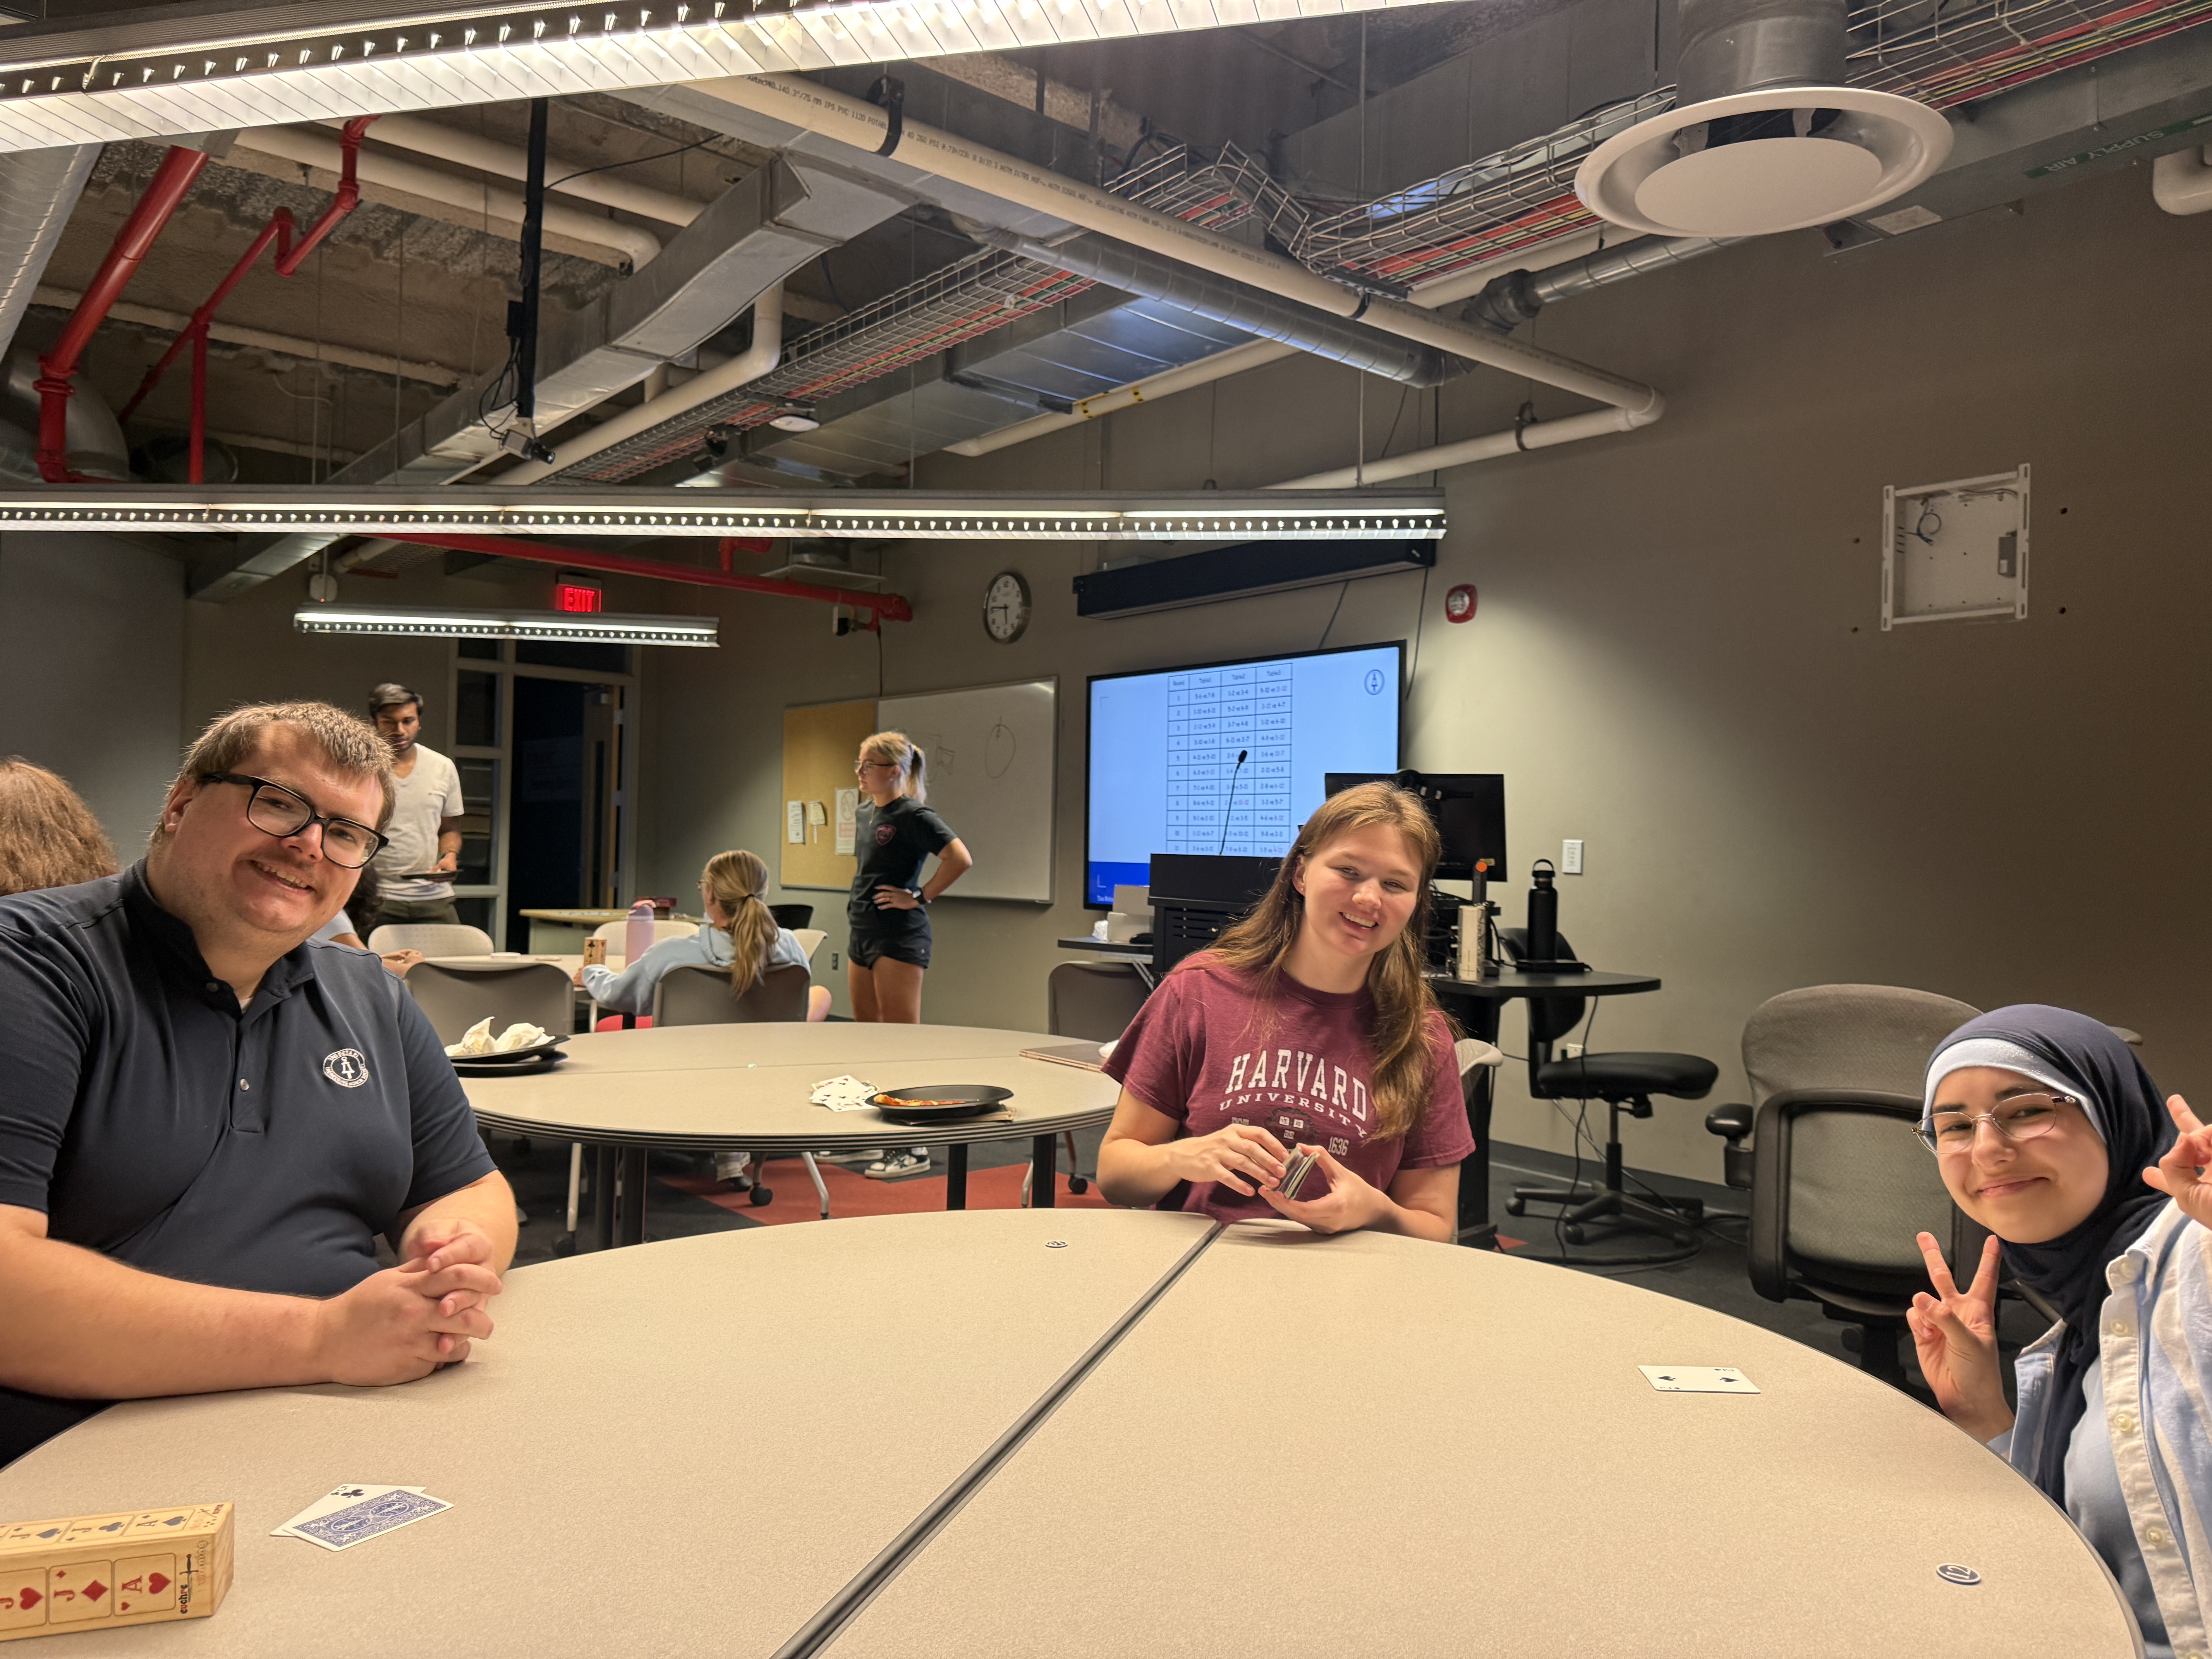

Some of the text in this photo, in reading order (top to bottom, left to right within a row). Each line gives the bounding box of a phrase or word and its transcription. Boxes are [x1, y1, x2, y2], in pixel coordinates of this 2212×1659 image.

[2044, 131, 2164, 172] SUPPLY AIR
[565, 588, 595, 611] EXIT
[1225, 1049, 1367, 1121] HARVARD
[1220, 1093, 1367, 1139] UNIVERSITY
[1328, 1136, 1349, 1156] 1636
[1946, 1565, 1971, 1579] 12
[54, 1589, 75, 1602] J
[122, 1575, 143, 1594] A
[179, 1584, 188, 1614] euchre
